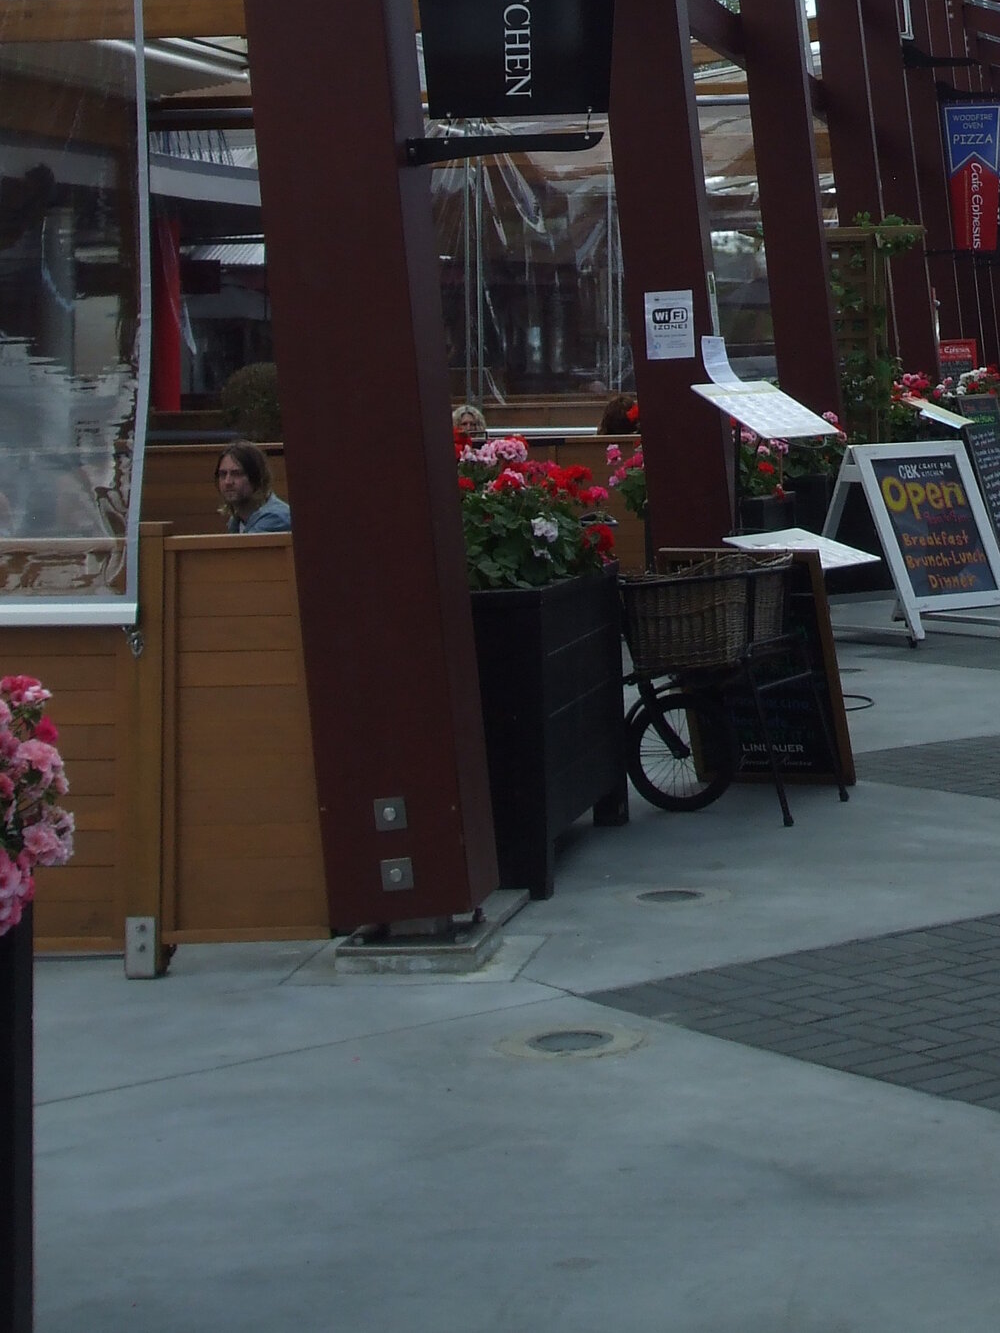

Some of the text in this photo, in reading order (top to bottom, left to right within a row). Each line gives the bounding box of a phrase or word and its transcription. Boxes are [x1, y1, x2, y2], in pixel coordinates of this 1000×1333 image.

[962, 122, 984, 130] OVEN
[953, 133, 993, 145] PIZZA
[970, 162, 983, 249] Cafe Ephesus
[899, 464, 920, 479] CBK
[882, 476, 965, 520] Open
[902, 530, 969, 547] Breakfast
[928, 574, 976, 589] Dinner
